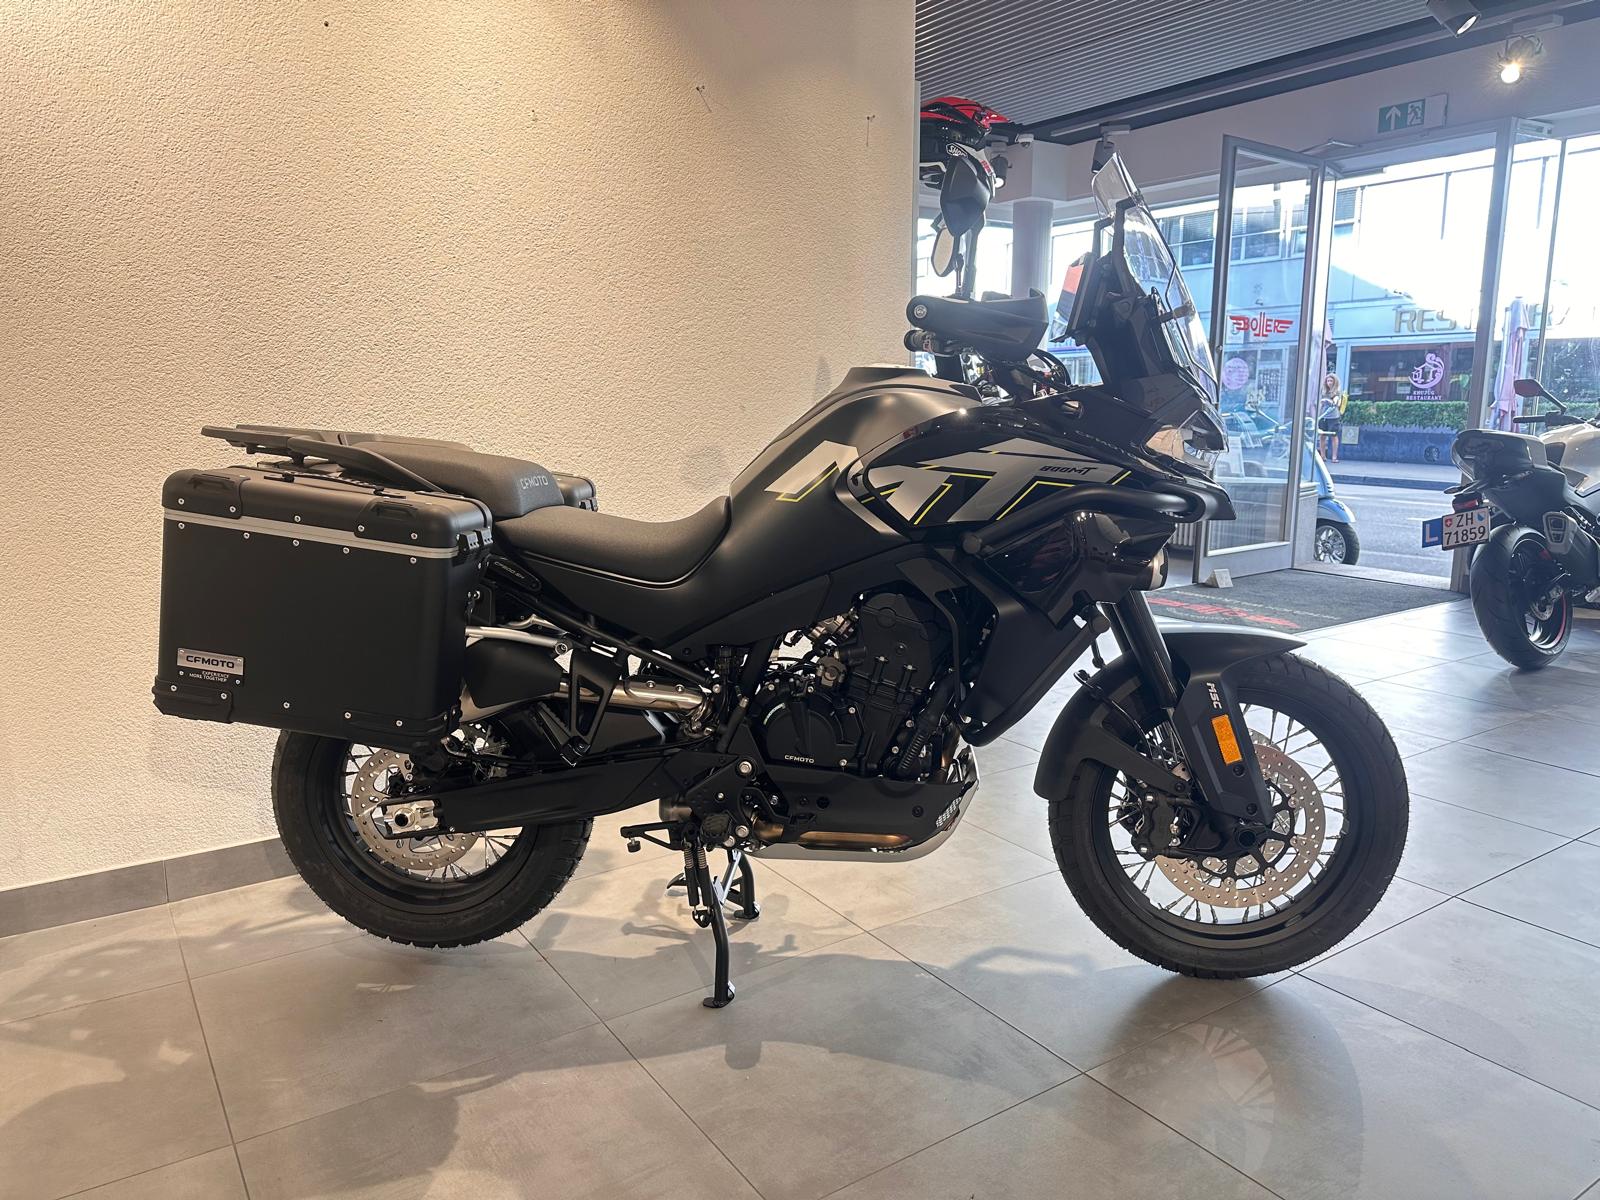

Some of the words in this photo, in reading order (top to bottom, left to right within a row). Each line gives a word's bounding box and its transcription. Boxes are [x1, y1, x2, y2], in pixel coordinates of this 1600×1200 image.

[1040, 465, 1098, 475] 800MT
[520, 475, 549, 489] CFMOTO
[1456, 512, 1474, 528] ZH
[1425, 523, 1438, 543] L
[1444, 525, 1486, 546] 71859
[186, 655, 235, 669] CFMOTO
[784, 754, 815, 764] CFMOTO
